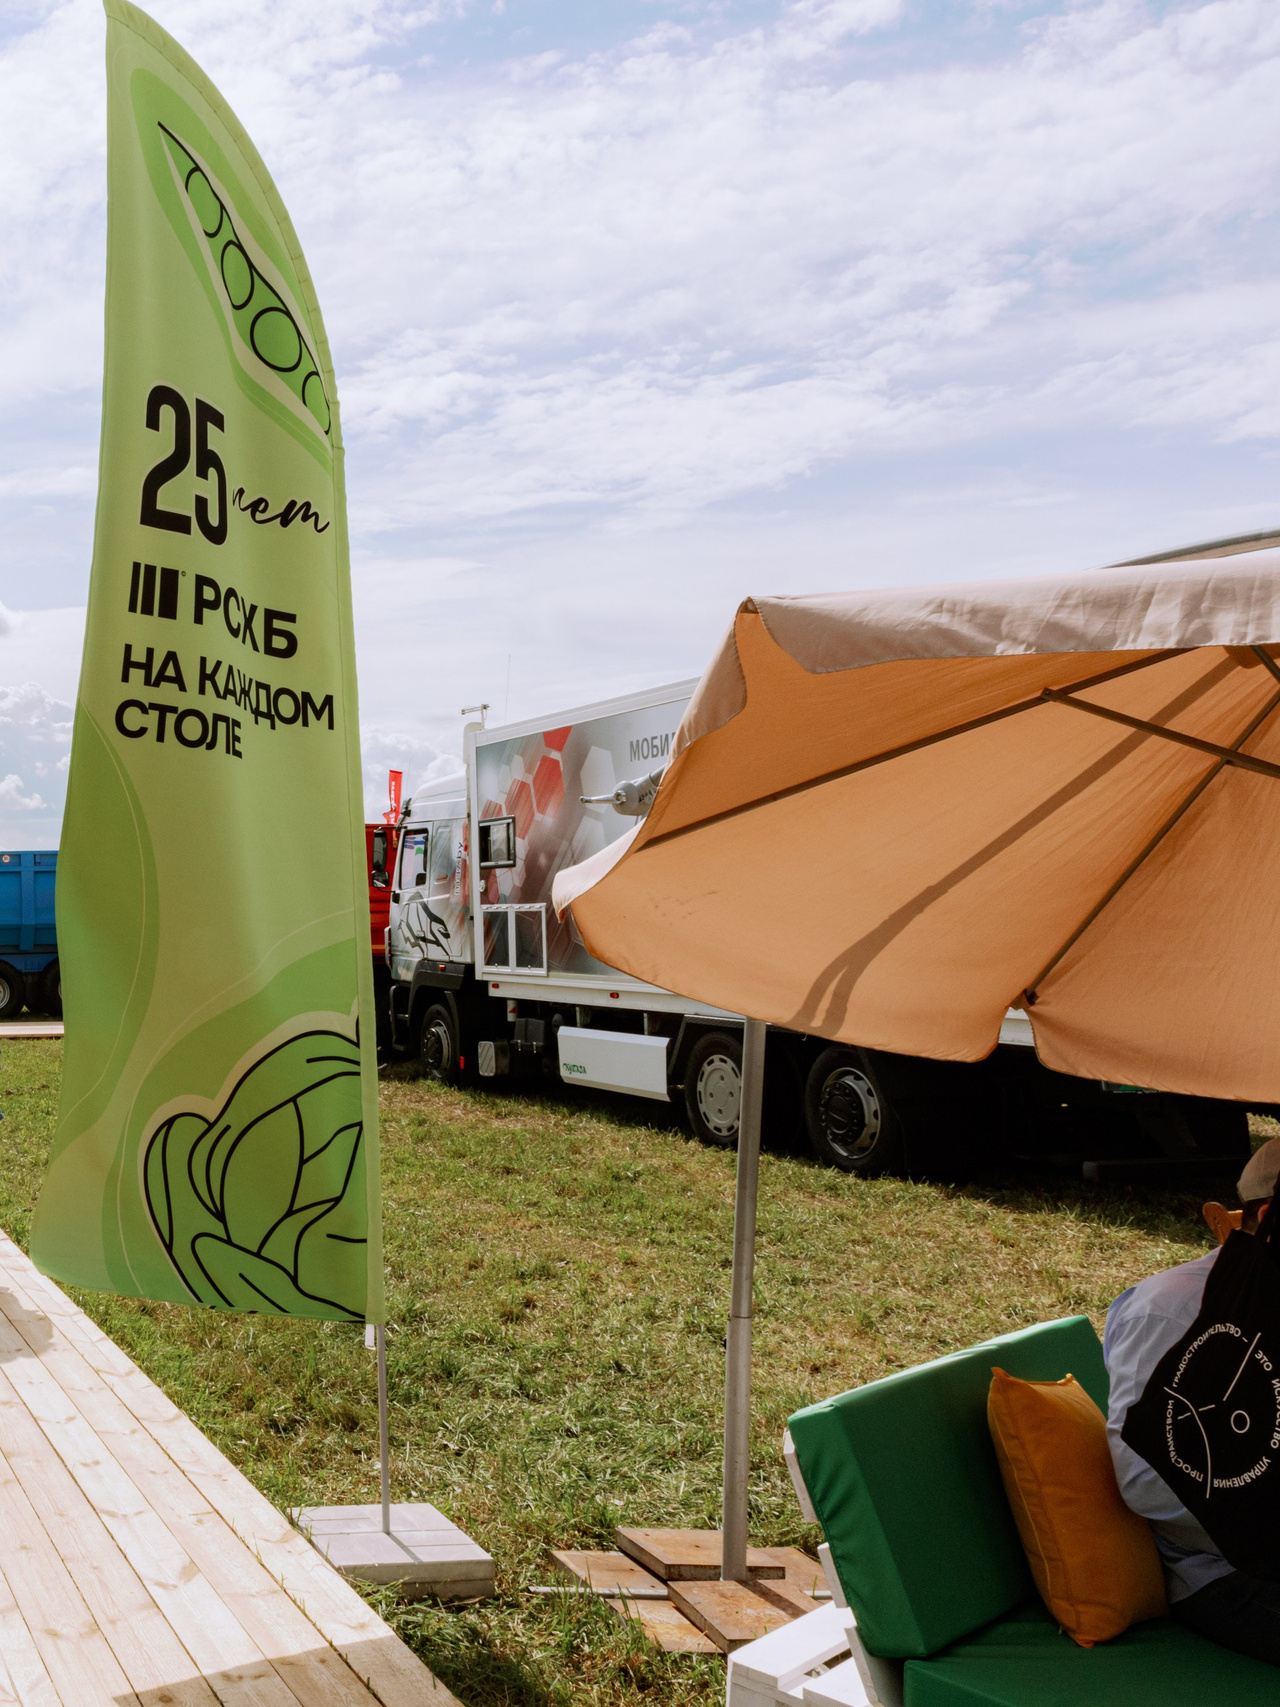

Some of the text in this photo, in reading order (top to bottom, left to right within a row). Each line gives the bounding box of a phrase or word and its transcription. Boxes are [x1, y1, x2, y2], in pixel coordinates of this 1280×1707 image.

[140, 385, 228, 546] 25
[193, 574, 299, 659] РСХБ
[121, 643, 335, 730] НА КАЖДОМ
[115, 698, 243, 759] СТОЛЕ
[629, 731, 677, 763] МОБИ
[1254, 1349, 1273, 1372] ЭТО
[1166, 1399, 1204, 1482] ПРОСТРАНСТВОМ
[1213, 1456, 1271, 1488] УПРАВЛЕНИЯ
